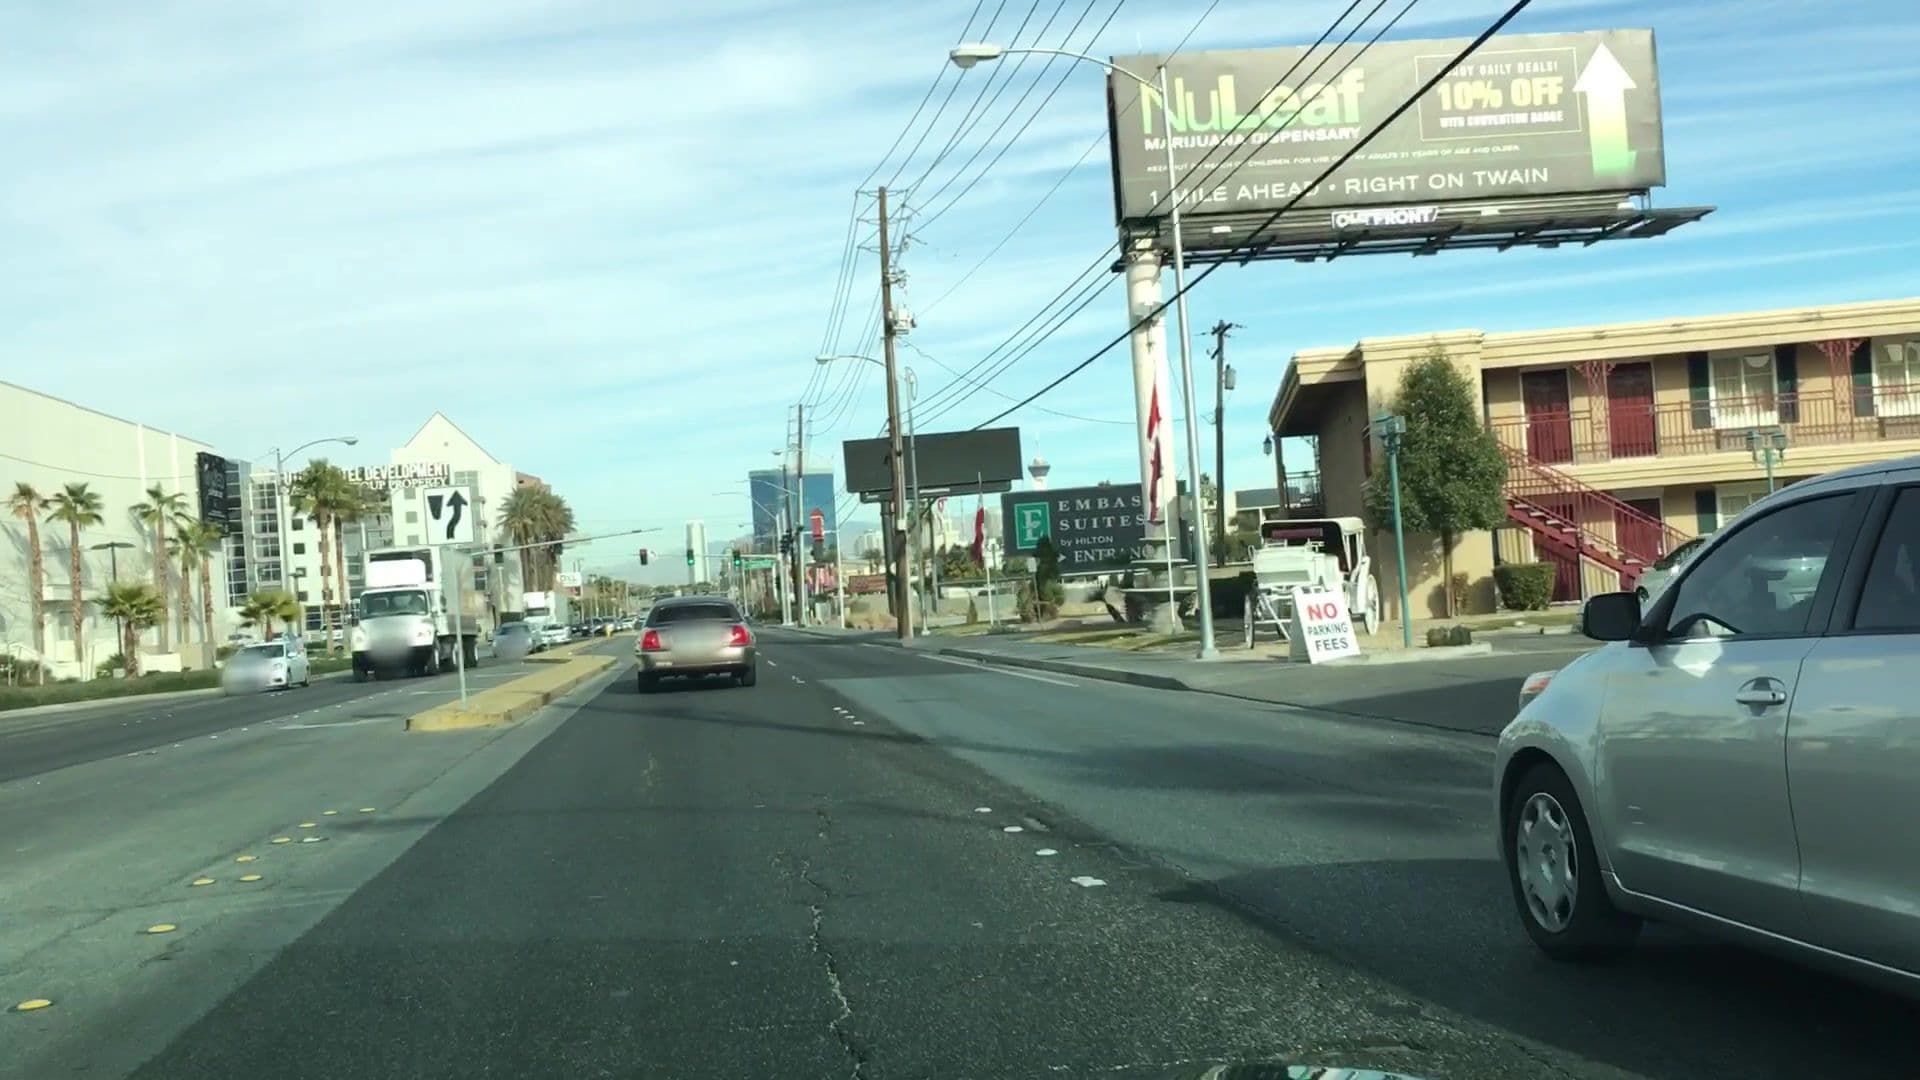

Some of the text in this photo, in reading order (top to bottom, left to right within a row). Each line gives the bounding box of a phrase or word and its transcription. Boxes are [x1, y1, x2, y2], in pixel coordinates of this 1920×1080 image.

[1480, 63, 1512, 75] DAILY
[1518, 61, 1558, 73] DEALS!
[1140, 68, 1365, 134] NuLeaf
[1437, 76, 1563, 111] 10% OFF
[1144, 127, 1361, 150] MARIJUANA DISPENSARY
[1150, 167, 1549, 205] 1 MILE AHEAD RIGHT ON TWAIN
[365, 463, 449, 481] DEVELOPMENT
[1058, 495, 1141, 512] EMBAS
[1059, 514, 1145, 531] SUITES
[1060, 536, 1113, 547] by HILTON
[1307, 603, 1337, 620] NO
[1307, 623, 1348, 635] PARKING
[1315, 637, 1348, 652] FEES
